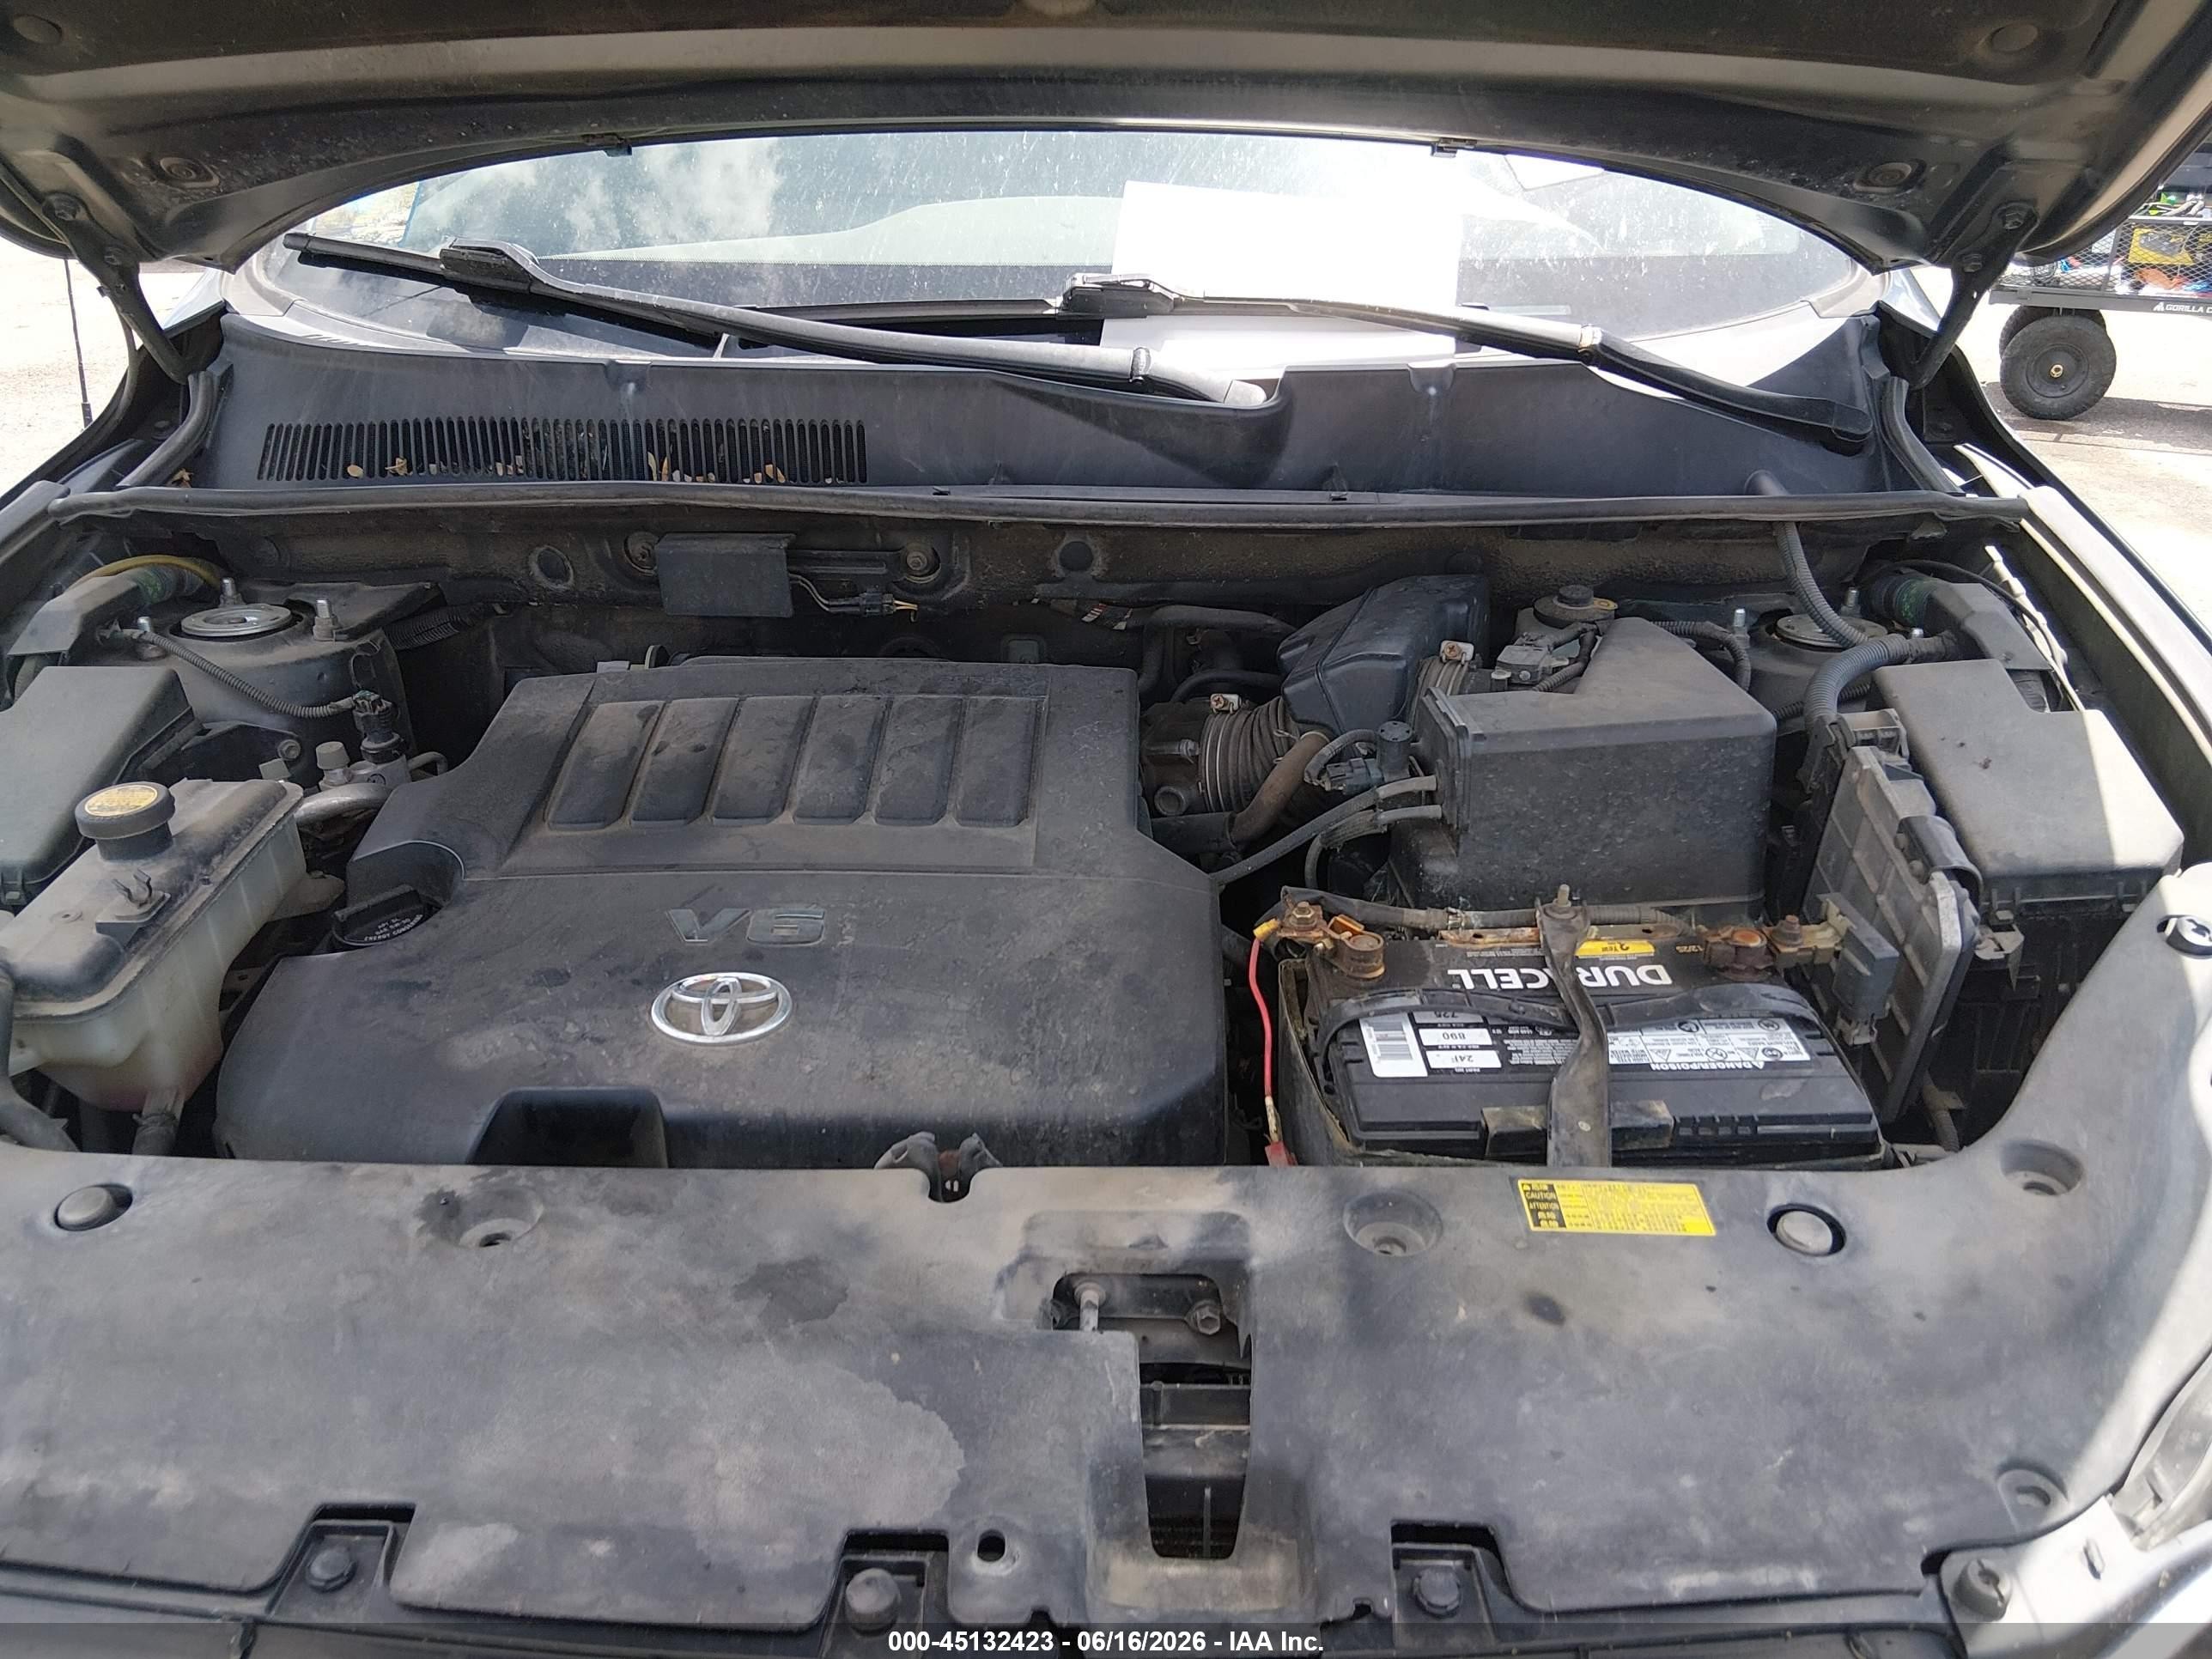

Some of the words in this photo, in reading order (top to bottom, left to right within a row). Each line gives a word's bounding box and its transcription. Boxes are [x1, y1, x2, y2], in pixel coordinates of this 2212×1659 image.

[2166, 304, 2204, 313] GORILLA
[665, 908, 825, 945] V6
[1448, 964, 1673, 989] DURCELL
[1650, 1061, 1753, 1070] DANGER/POISON
